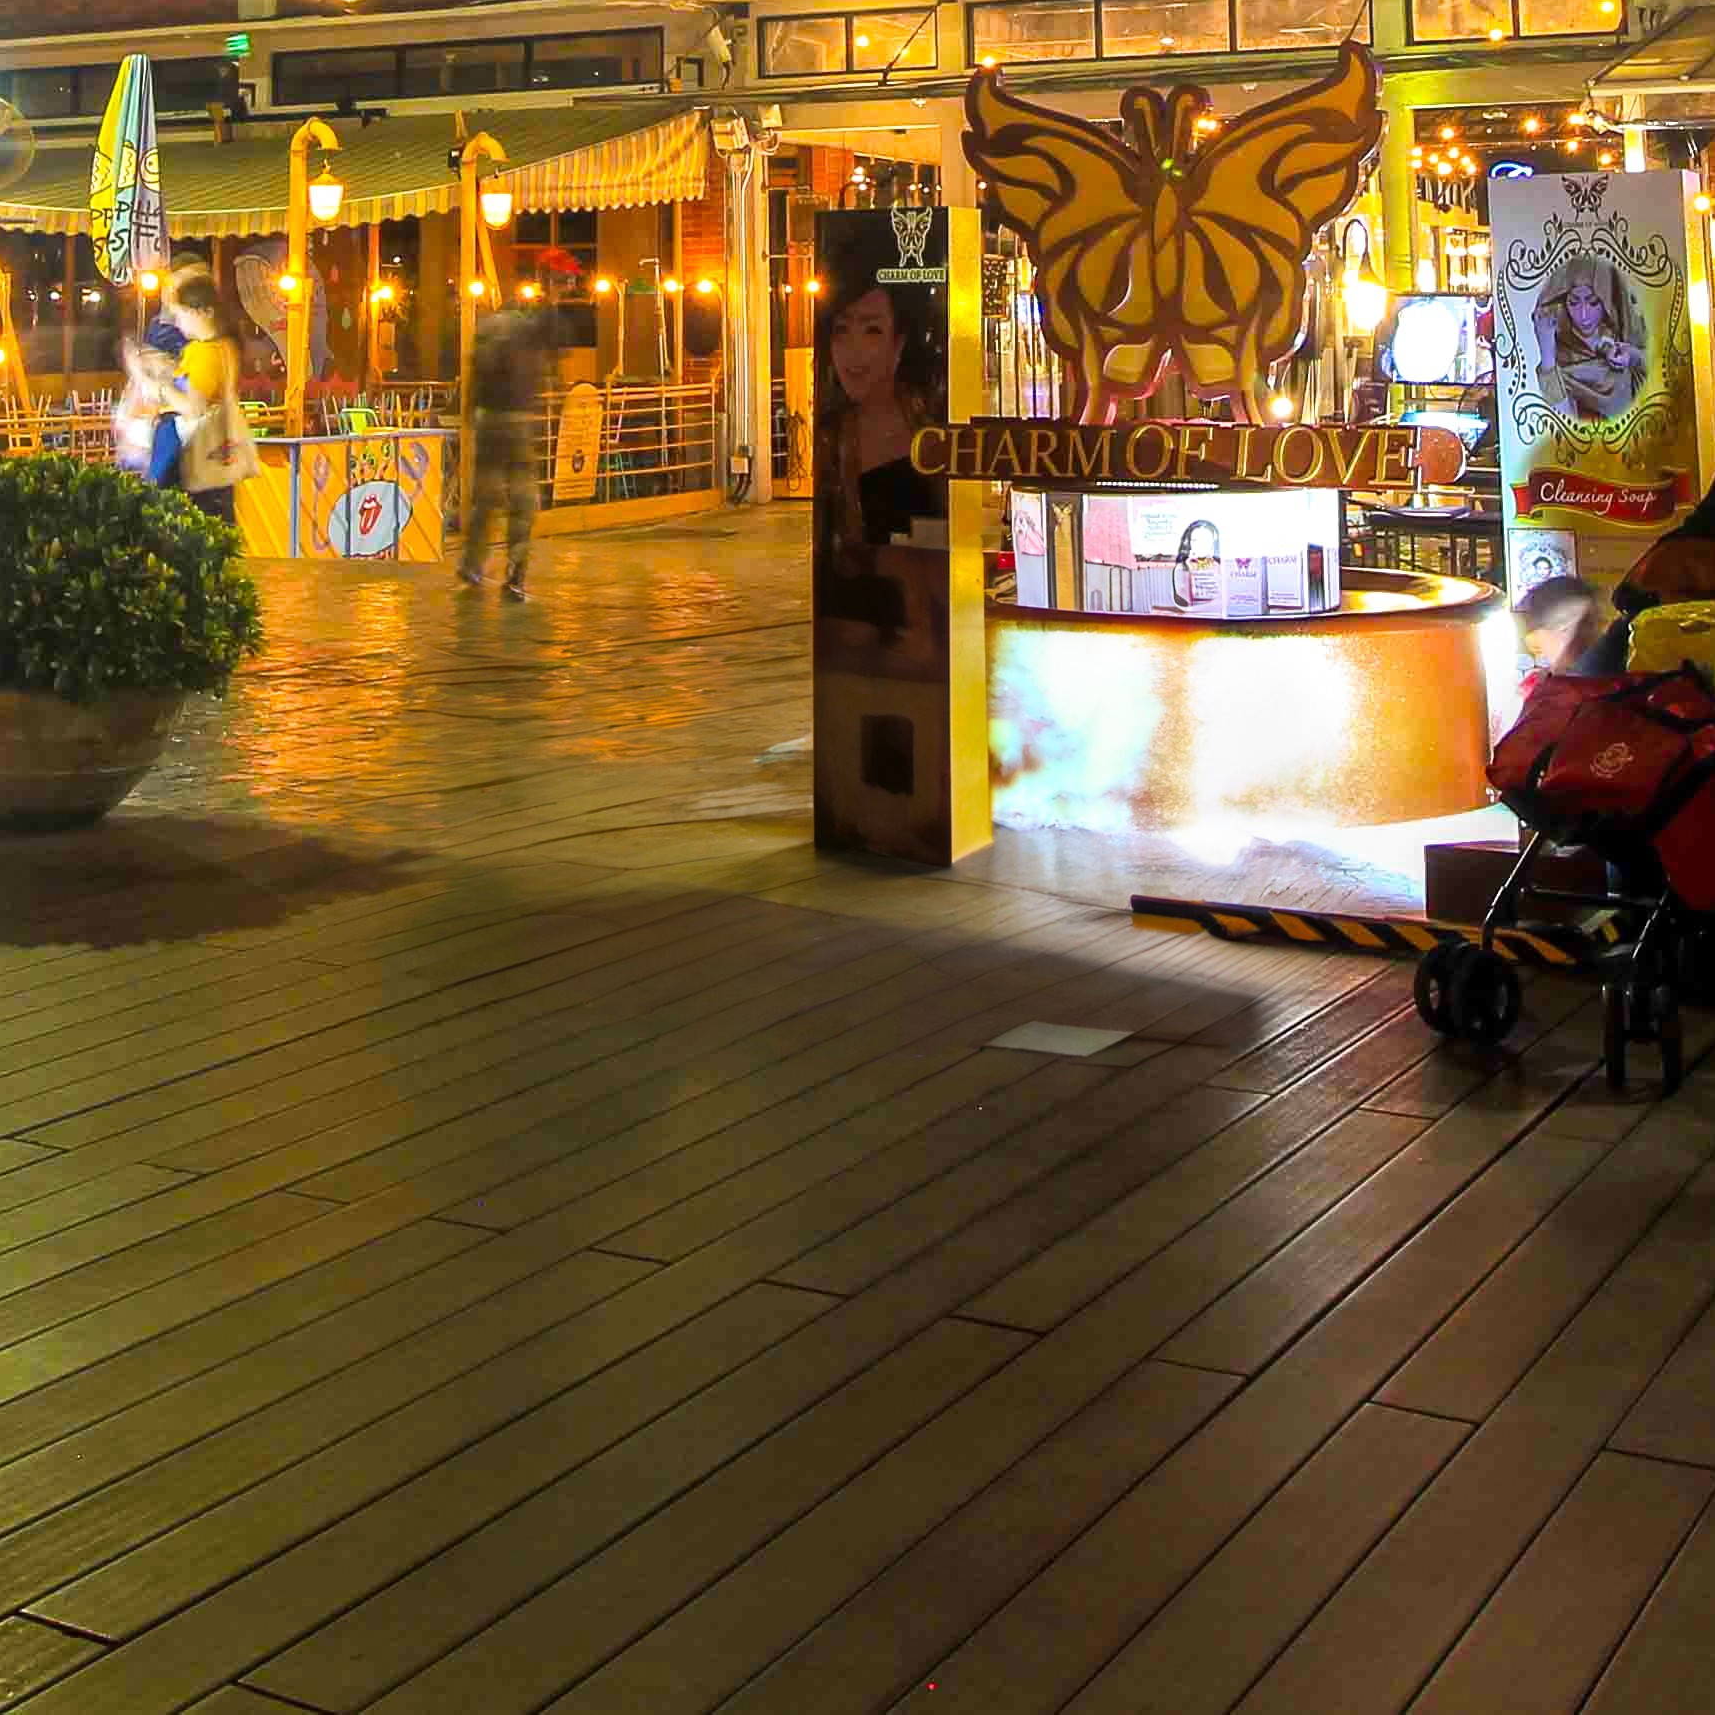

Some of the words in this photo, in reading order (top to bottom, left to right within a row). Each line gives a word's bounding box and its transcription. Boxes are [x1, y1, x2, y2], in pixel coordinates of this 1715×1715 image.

[909, 424, 1119, 479] CHARM
[1125, 423, 1214, 481] OF
[1234, 424, 1420, 486] LOVE
[1539, 477, 1614, 516] Cleansing
[1617, 488, 1657, 514] Soap
